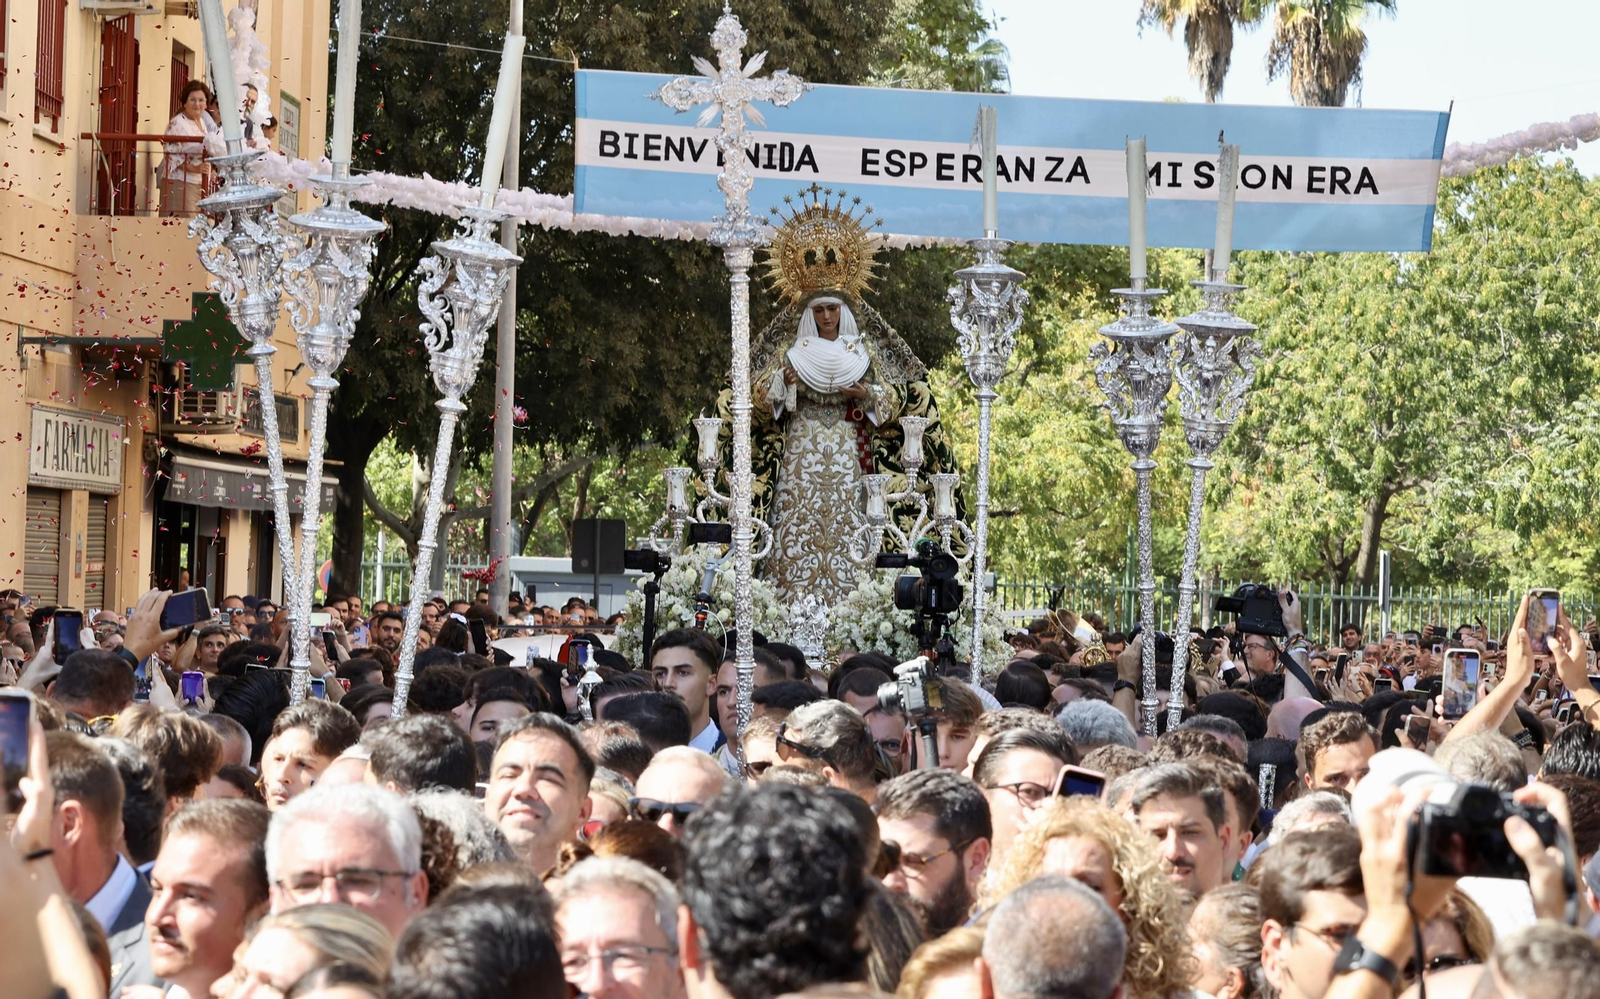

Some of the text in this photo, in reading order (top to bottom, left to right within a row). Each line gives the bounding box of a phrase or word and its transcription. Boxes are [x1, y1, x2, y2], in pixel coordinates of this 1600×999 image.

[599, 130, 1379, 195] BIENVNIDA ESPERANZA MISONERA
[43, 419, 110, 476] FARMACIA
